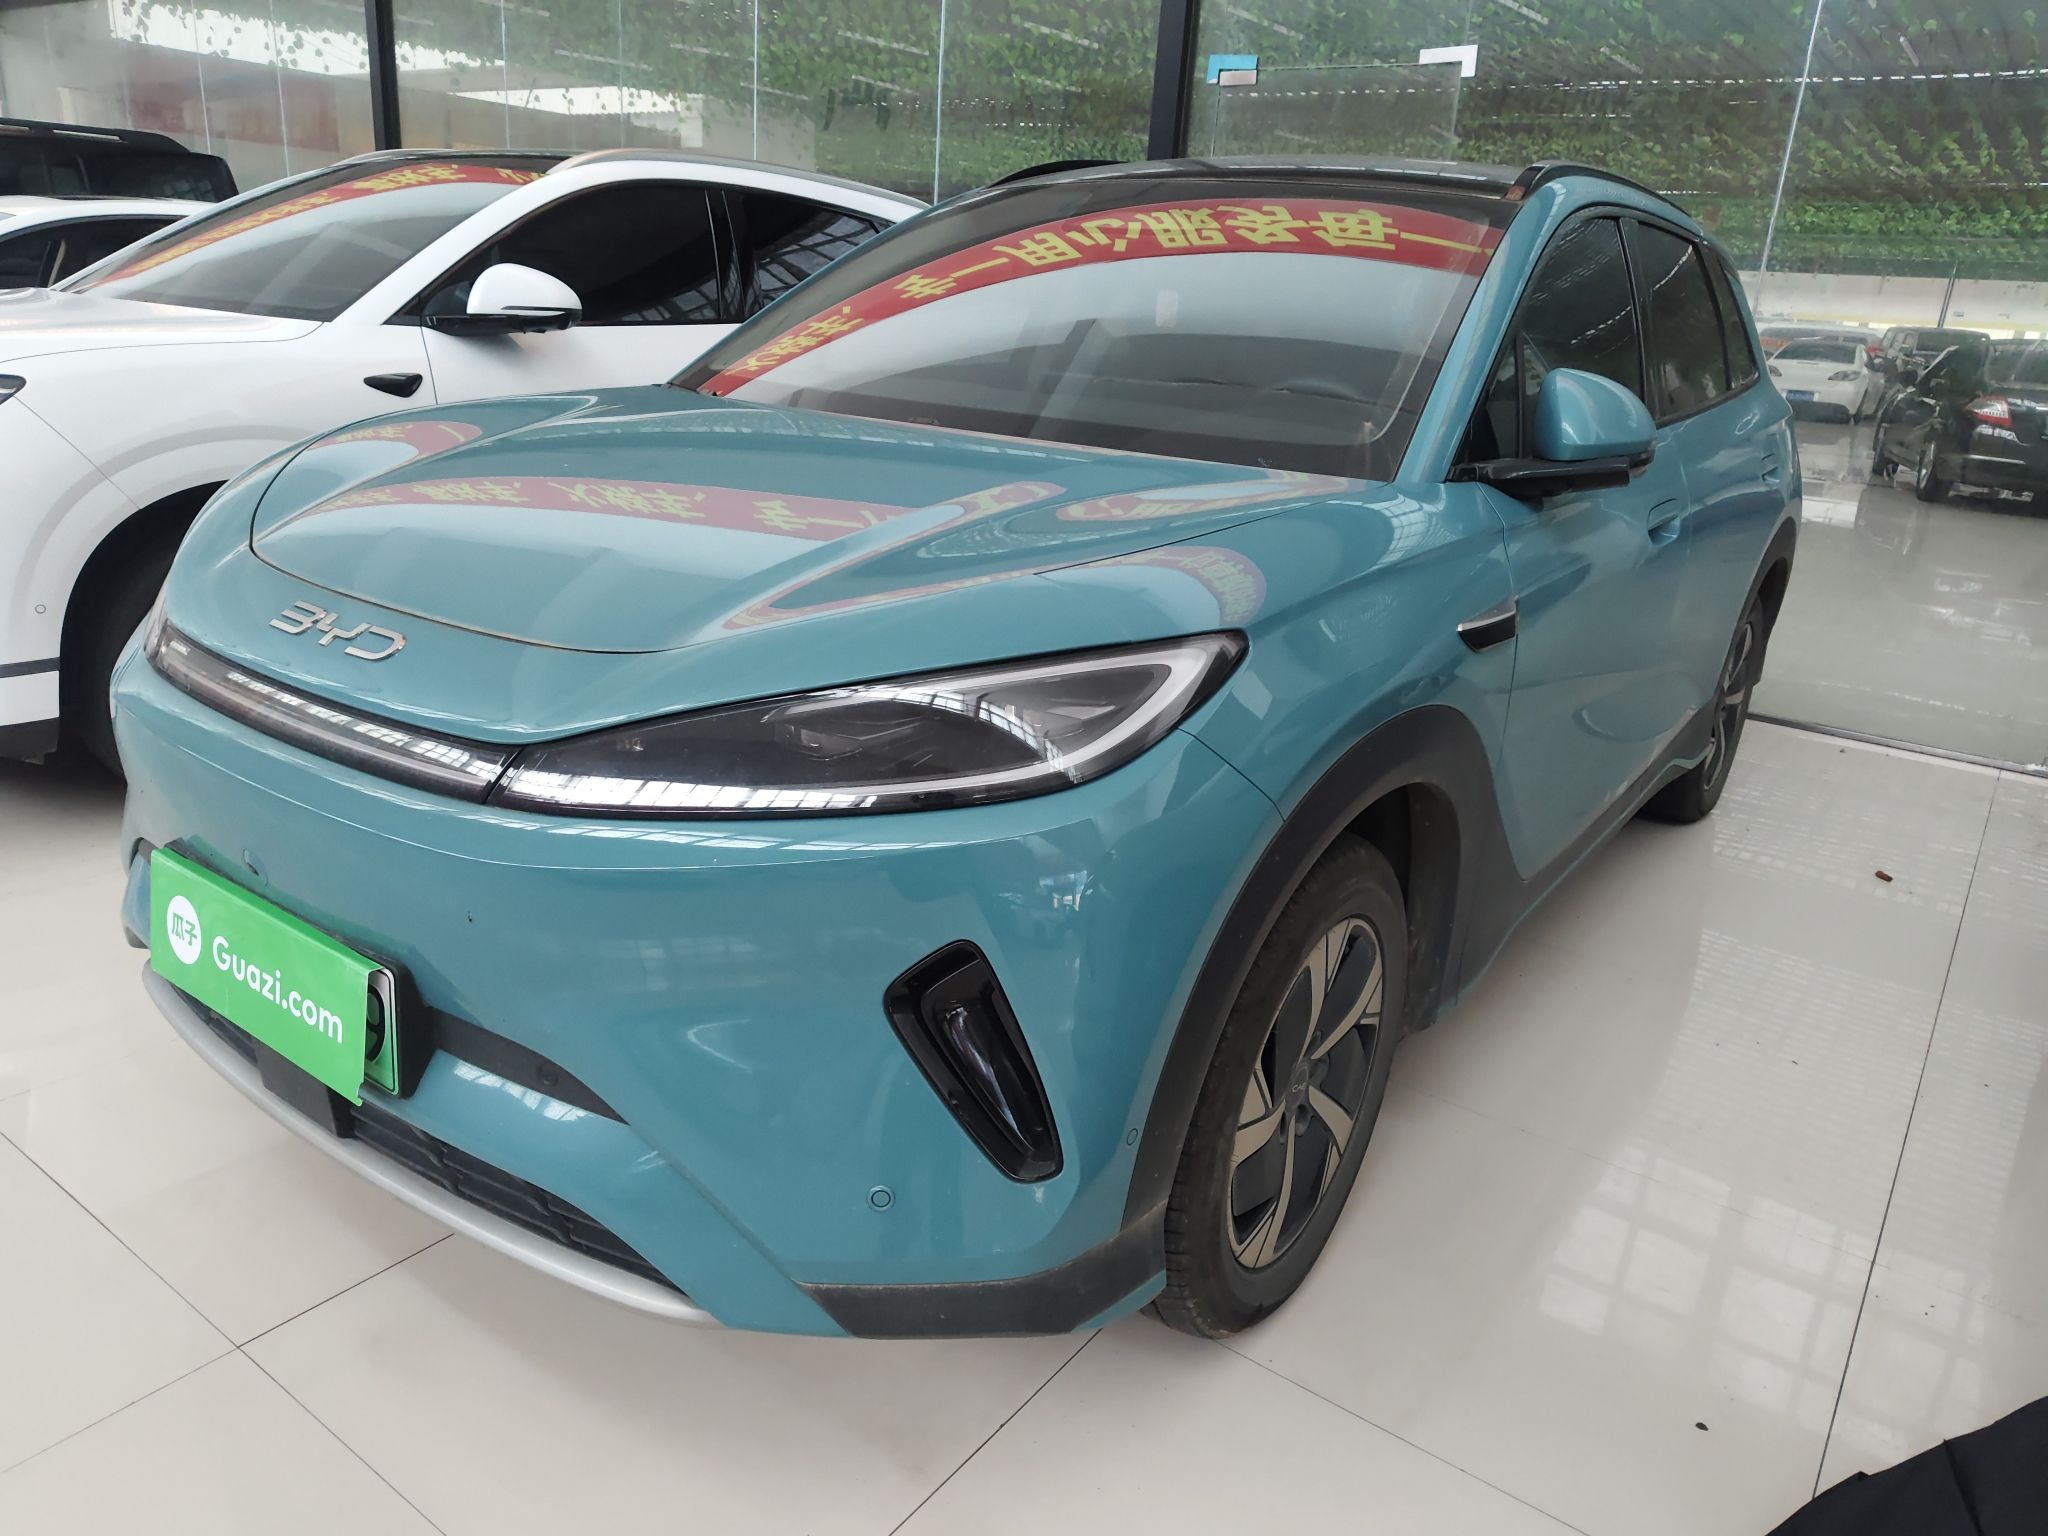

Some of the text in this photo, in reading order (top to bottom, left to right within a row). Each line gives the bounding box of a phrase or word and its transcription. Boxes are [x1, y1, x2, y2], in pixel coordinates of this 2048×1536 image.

[269, 600, 406, 661] BYD
[171, 912, 198, 946] 瓜子
[212, 935, 343, 1044] Guazi.com
